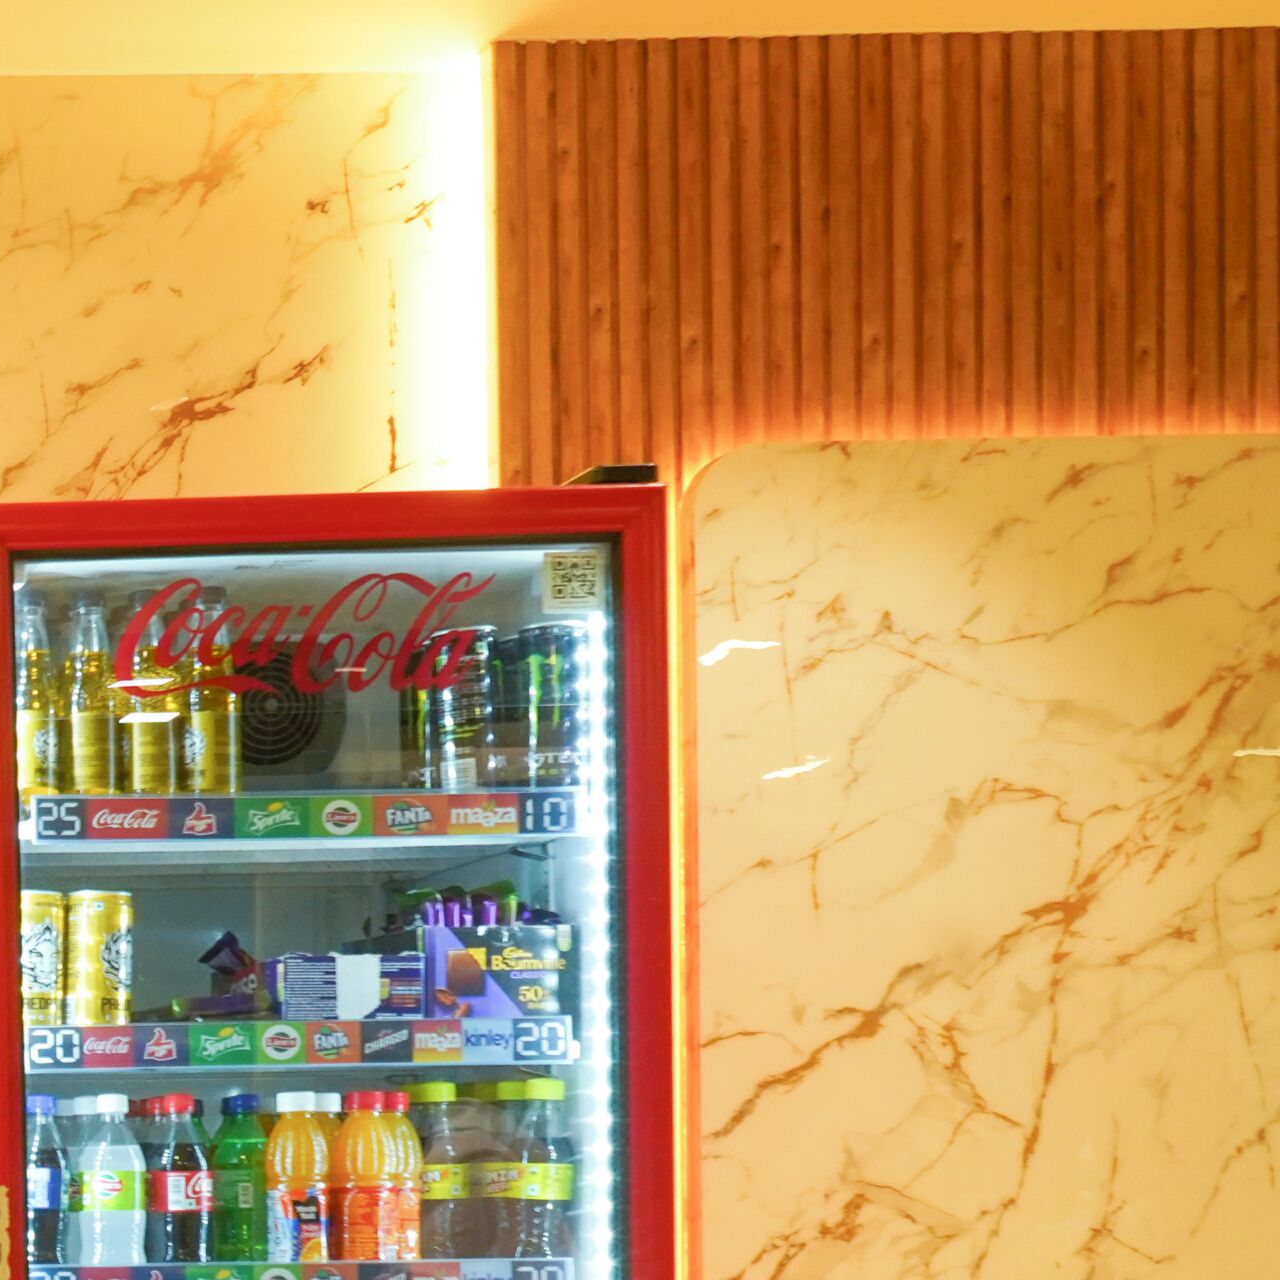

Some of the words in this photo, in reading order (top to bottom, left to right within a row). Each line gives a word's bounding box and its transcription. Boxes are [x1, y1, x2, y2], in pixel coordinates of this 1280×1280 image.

[113, 571, 498, 699] Coca-Cola
[39, 801, 81, 836] 25
[92, 809, 161, 830] Coca-Cola
[526, 797, 568, 832] 10
[30, 1029, 80, 1064] 20
[83, 1036, 131, 1055] Coca-Cola
[465, 1029, 512, 1052] kinley
[516, 1021, 567, 1057] 20
